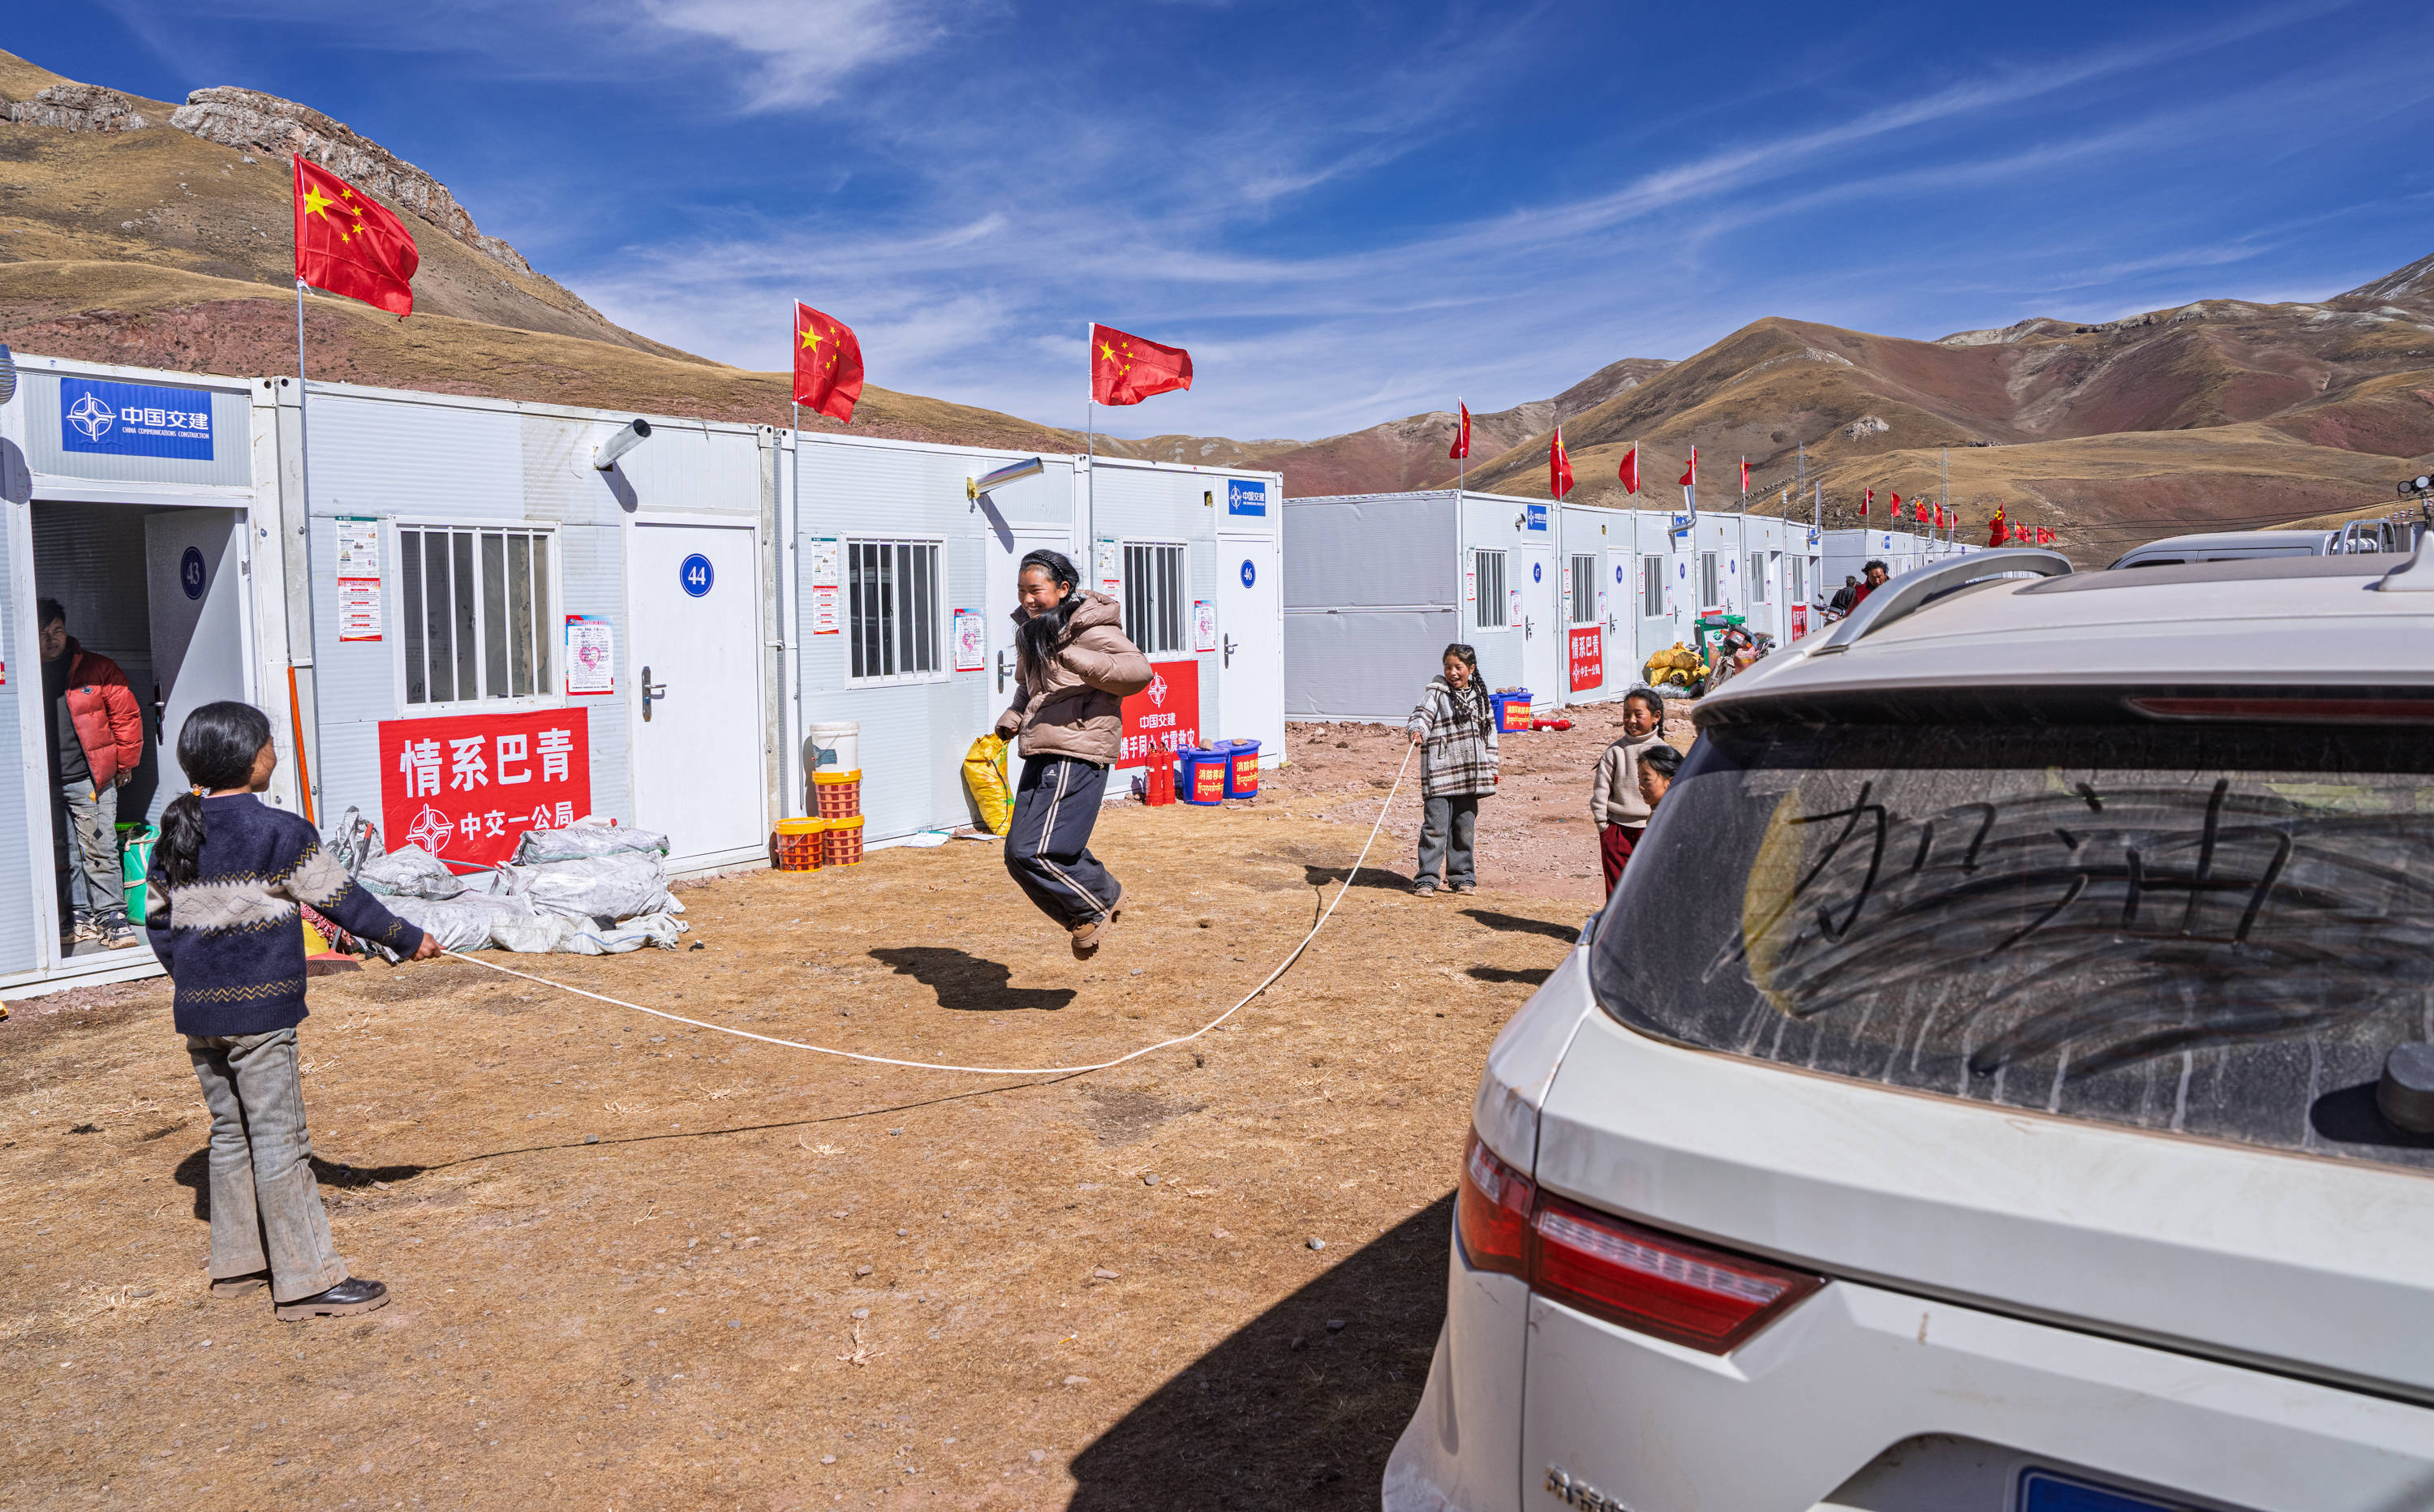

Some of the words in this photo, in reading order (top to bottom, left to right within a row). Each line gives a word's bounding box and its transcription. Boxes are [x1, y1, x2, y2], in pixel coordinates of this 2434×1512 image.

[121, 406, 209, 430] 中国交建
[138, 427, 176, 437] COMMUNICATIONS
[178, 431, 209, 439] CONSTRUCTION
[187, 561, 200, 584] 43
[688, 566, 706, 585] 44
[1244, 568, 1253, 581] 46
[1572, 634, 1599, 659] 情系巴青
[1139, 712, 1176, 729] 中国交建
[399, 728, 574, 798] 情系巴青
[460, 801, 574, 841] 中交一公局
[1733, 780, 2293, 963] 加油
